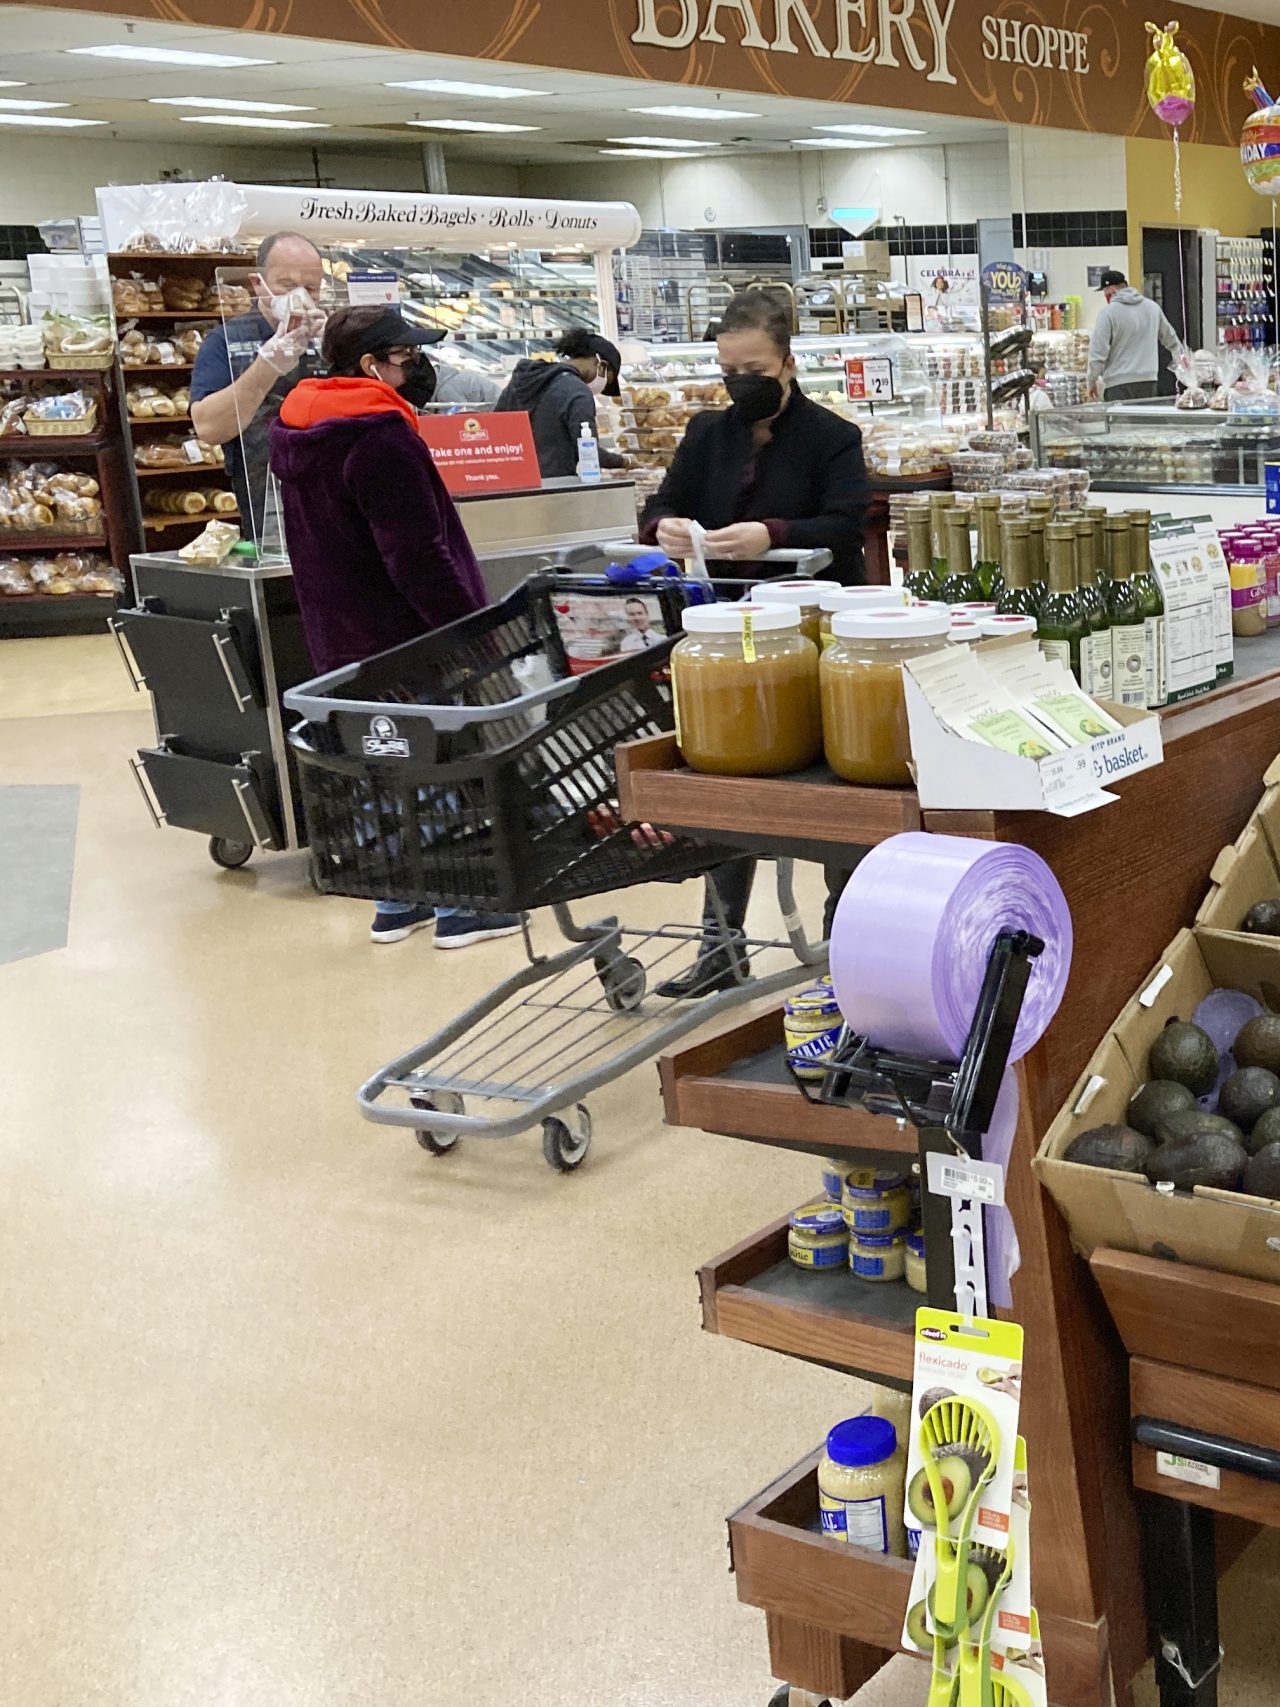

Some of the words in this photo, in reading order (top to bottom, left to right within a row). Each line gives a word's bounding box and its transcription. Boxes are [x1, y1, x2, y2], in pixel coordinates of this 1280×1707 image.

[631, 0, 957, 84] BAKERY
[981, 14, 1089, 74] SHOPPE
[300, 197, 353, 220] Fresh
[355, 201, 417, 223] Baked
[419, 203, 477, 228] Bagels
[489, 206, 534, 228] Rolls
[545, 208, 598, 230] Donuts
[430, 447, 452, 458] Take
[454, 447, 472, 456] one
[474, 444, 492, 455] and
[495, 443, 523, 455] enjoy!
[1106, 734, 1125, 746] BRAND
